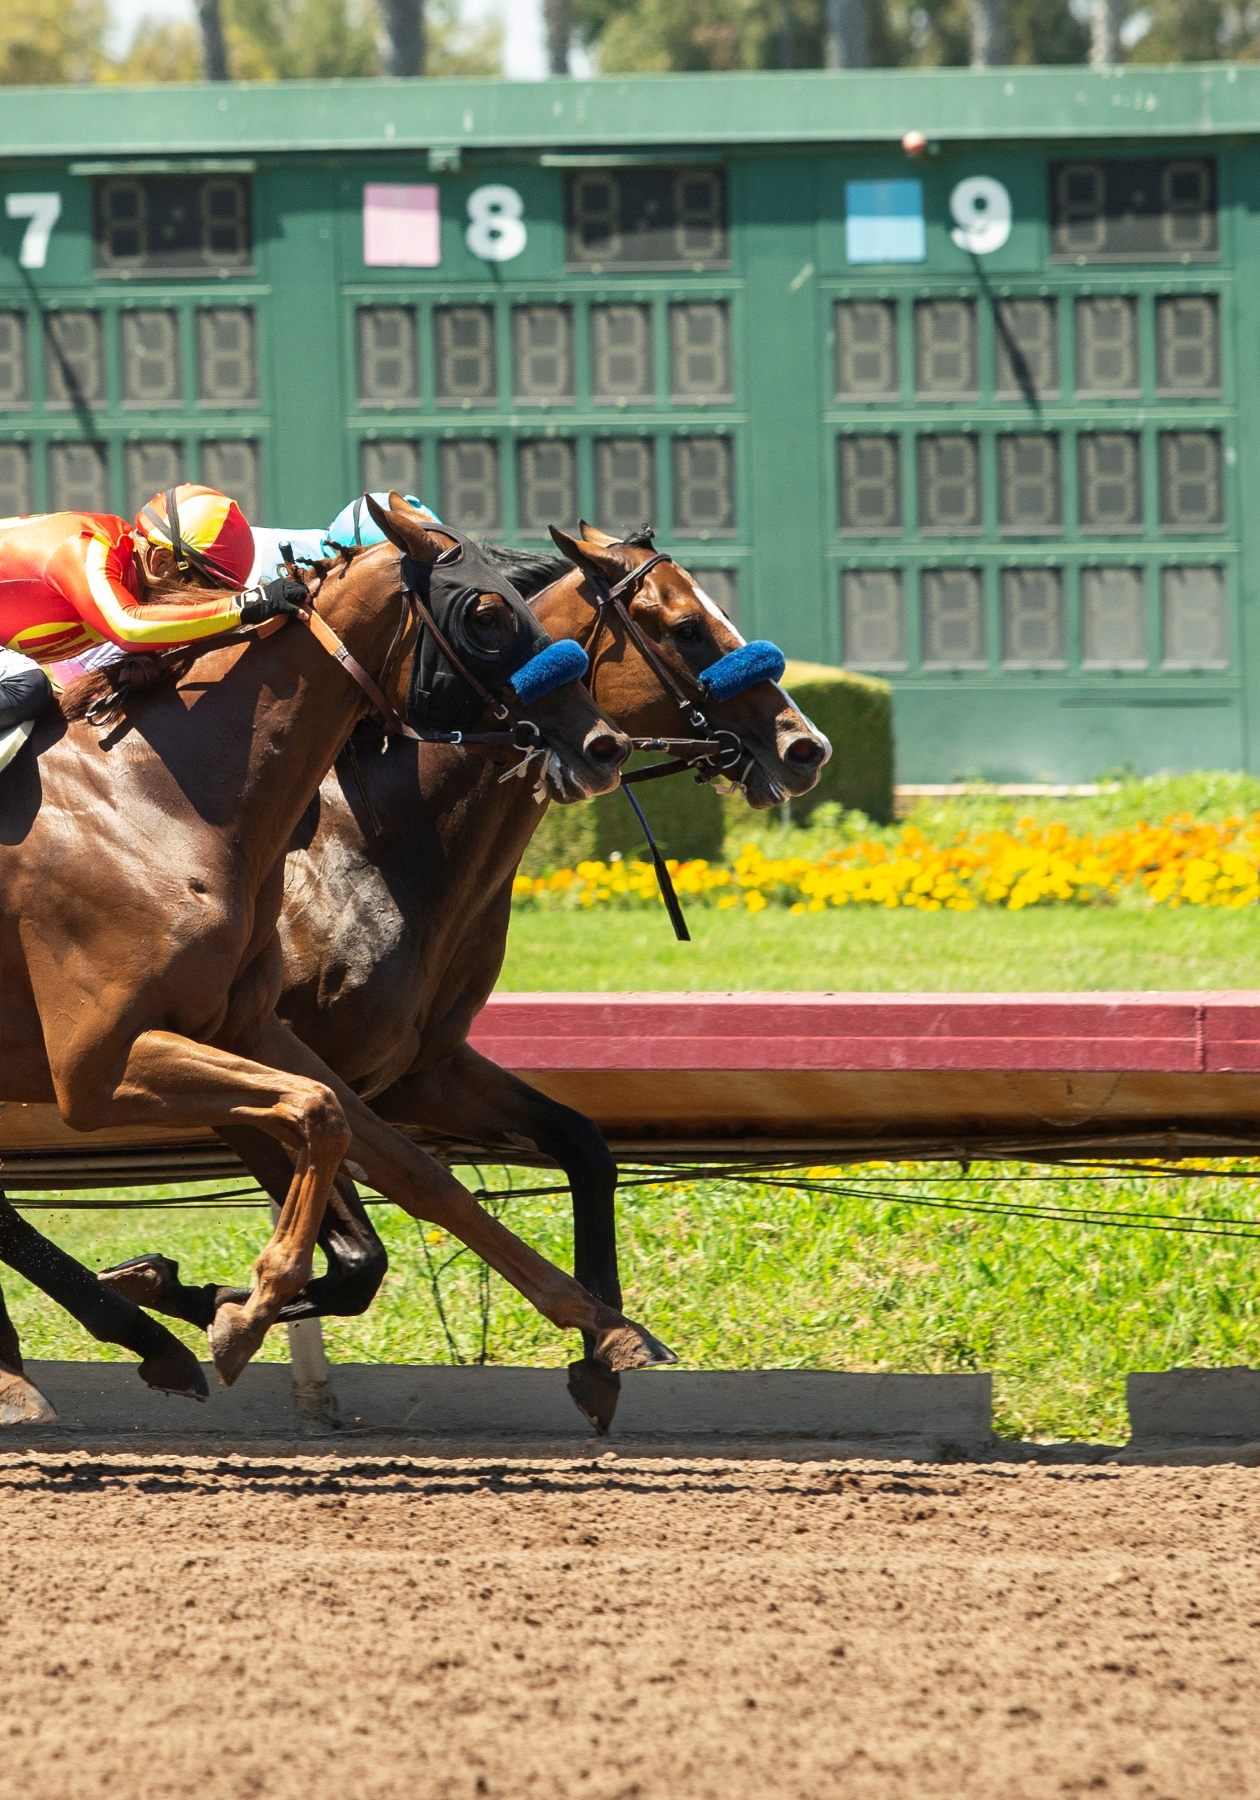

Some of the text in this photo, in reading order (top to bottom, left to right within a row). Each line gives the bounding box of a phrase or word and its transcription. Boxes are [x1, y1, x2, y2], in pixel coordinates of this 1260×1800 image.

[6, 192, 61, 268] 7
[466, 184, 527, 262] 8
[950, 176, 1012, 255] 9
